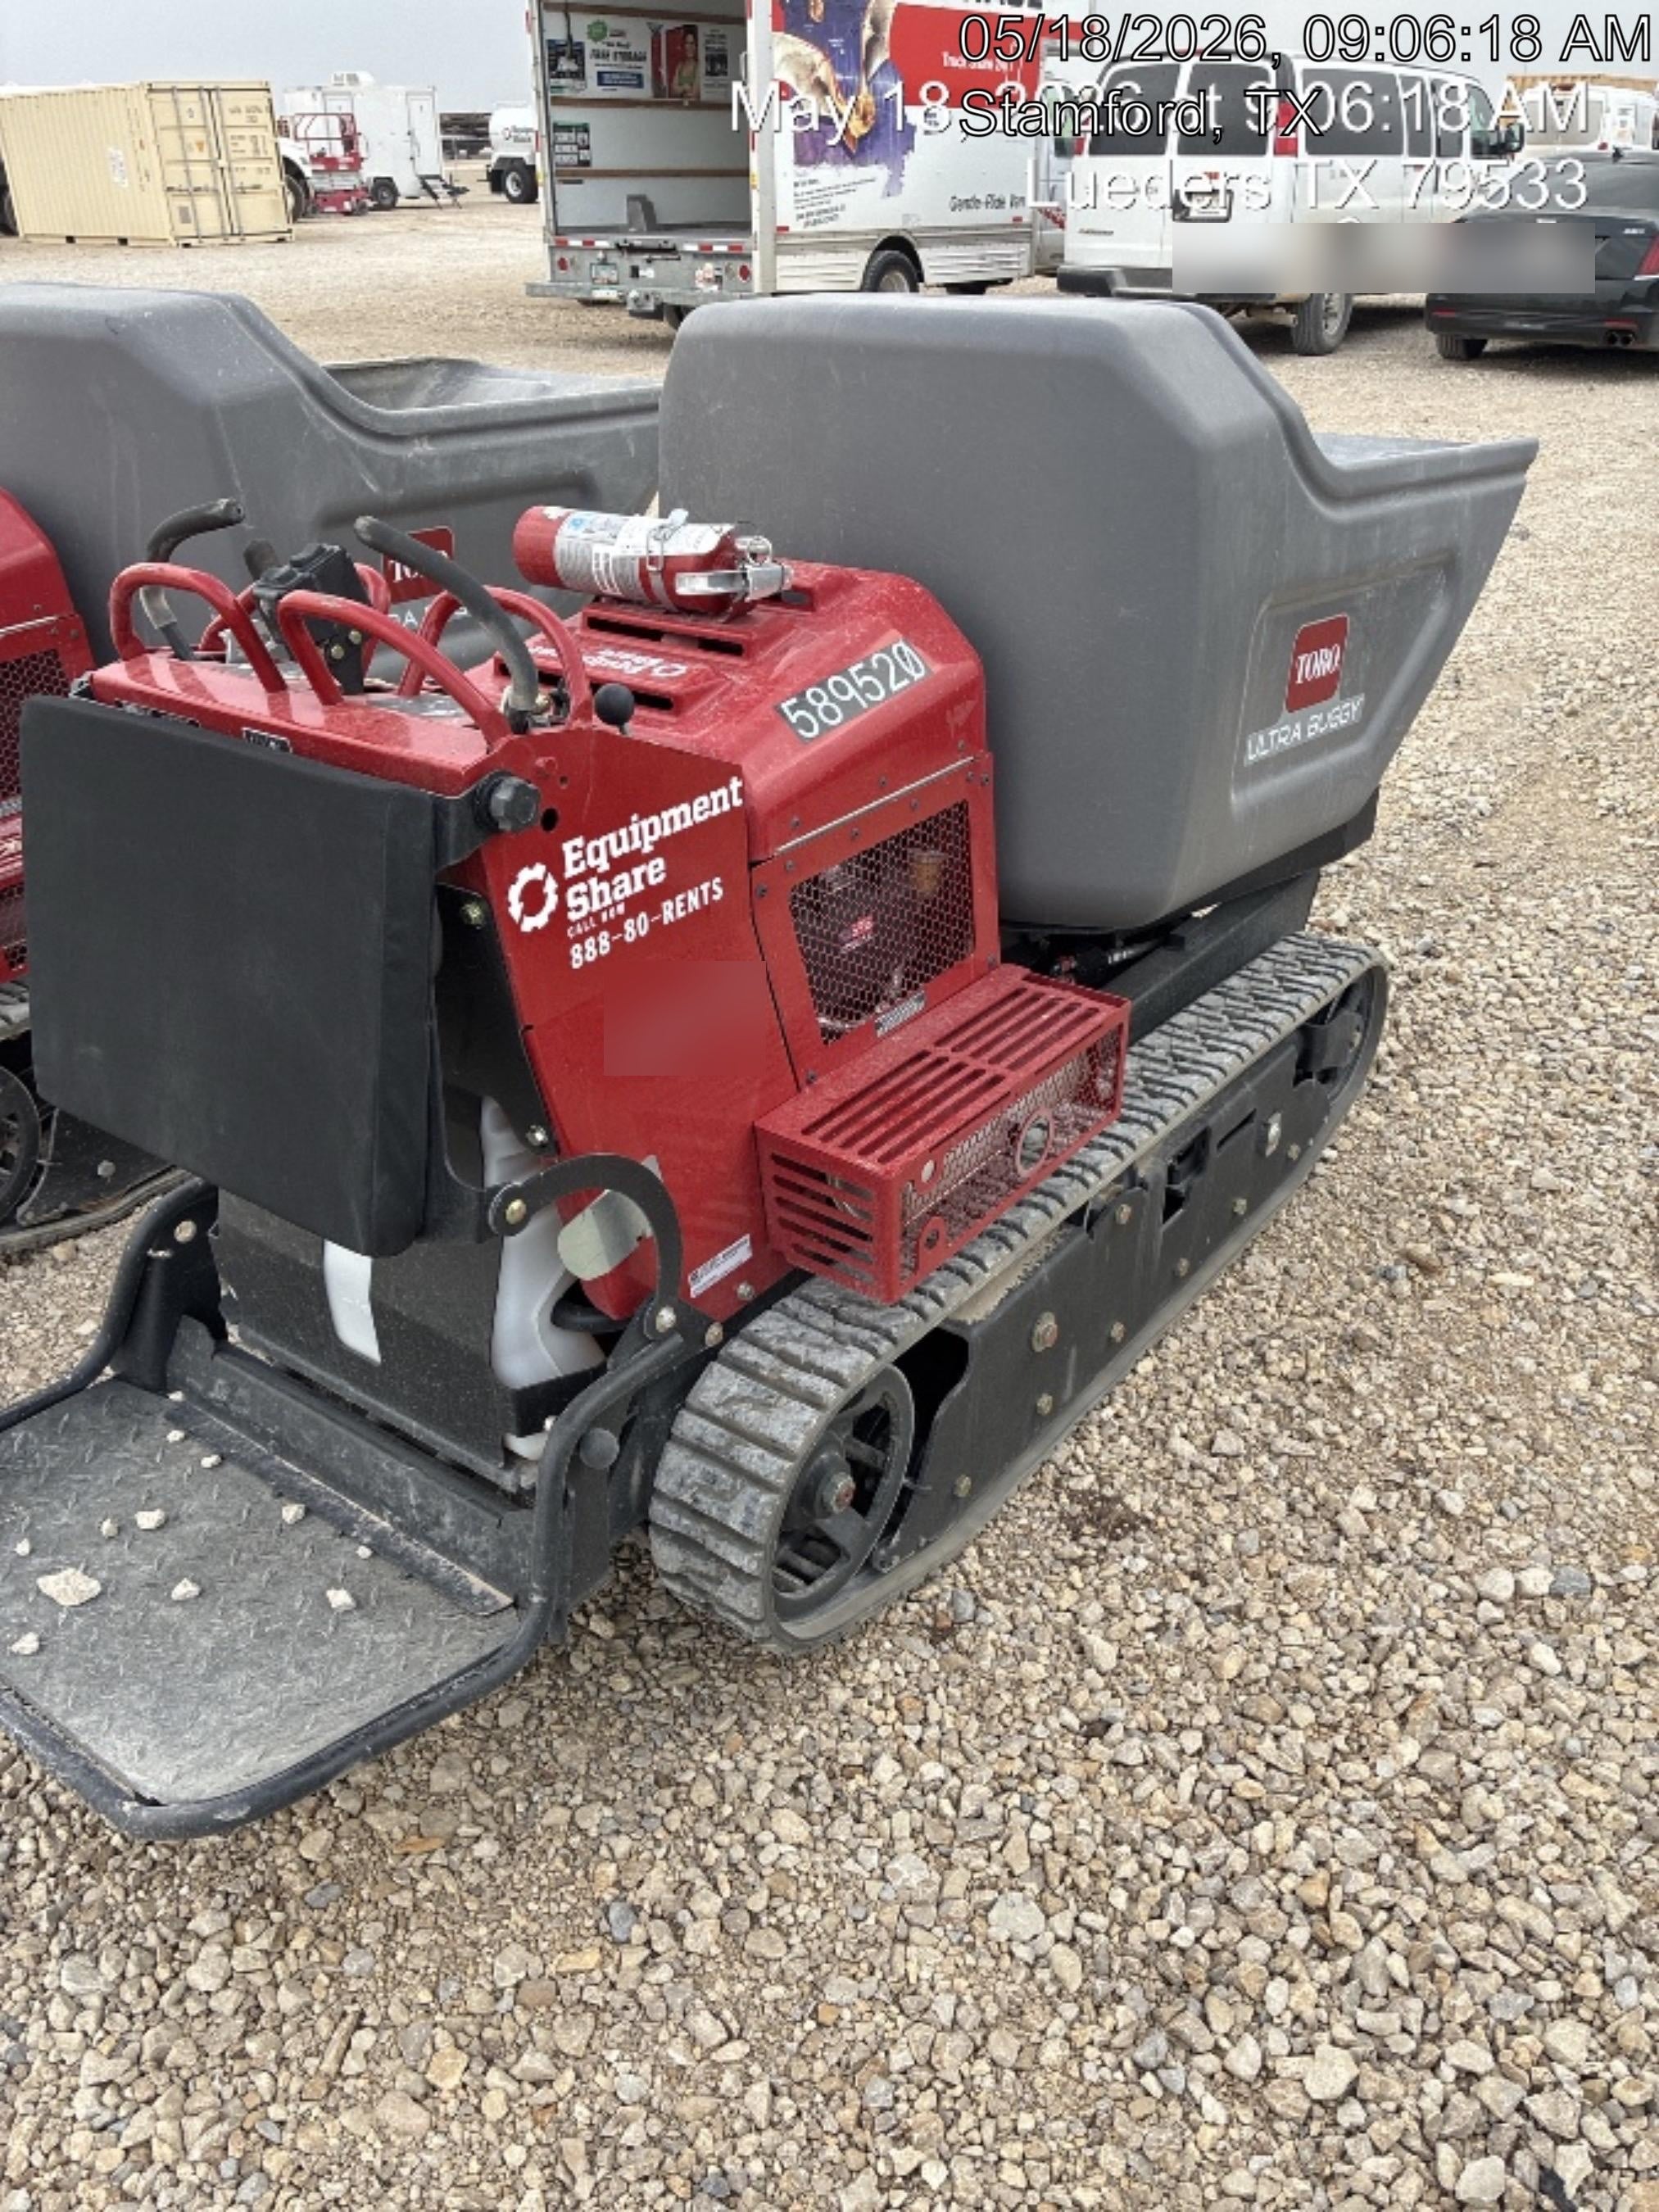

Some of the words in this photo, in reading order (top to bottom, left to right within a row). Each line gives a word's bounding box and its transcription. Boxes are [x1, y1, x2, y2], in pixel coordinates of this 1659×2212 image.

[780, 638, 926, 739] 589520
[1295, 643, 1342, 685] TORO
[1246, 720, 1302, 763] ULTRA
[1306, 696, 1365, 739] BUGGY
[561, 776, 744, 879] Equipment
[566, 856, 668, 922] Share
[569, 876, 724, 970] 888-80-RENTS
